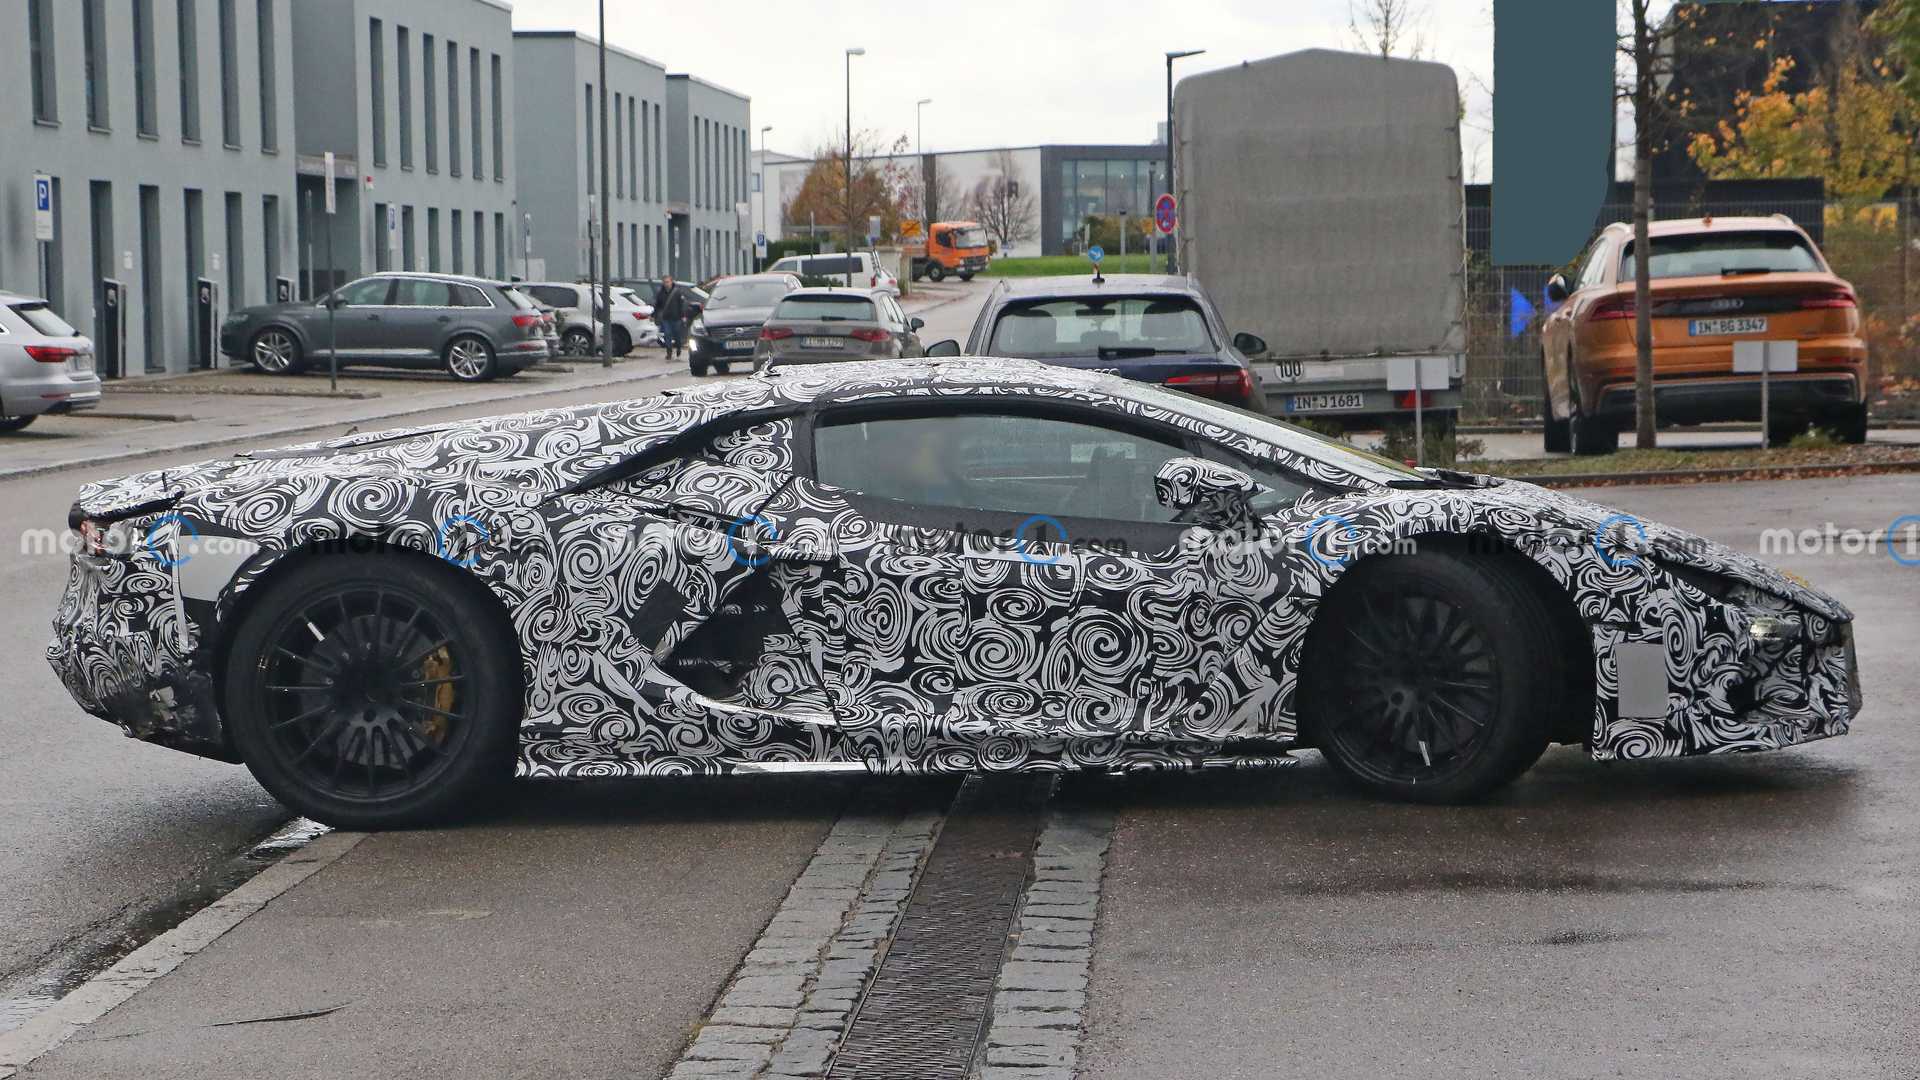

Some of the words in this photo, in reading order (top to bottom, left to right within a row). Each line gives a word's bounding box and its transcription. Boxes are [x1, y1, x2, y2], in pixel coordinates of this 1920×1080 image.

[38, 182, 48, 208] P
[1698, 321, 1713, 334] IN
[1720, 319, 1735, 333] BG
[1737, 318, 1765, 332] 3347
[1280, 360, 1302, 379] 100
[1296, 396, 1312, 409] IN
